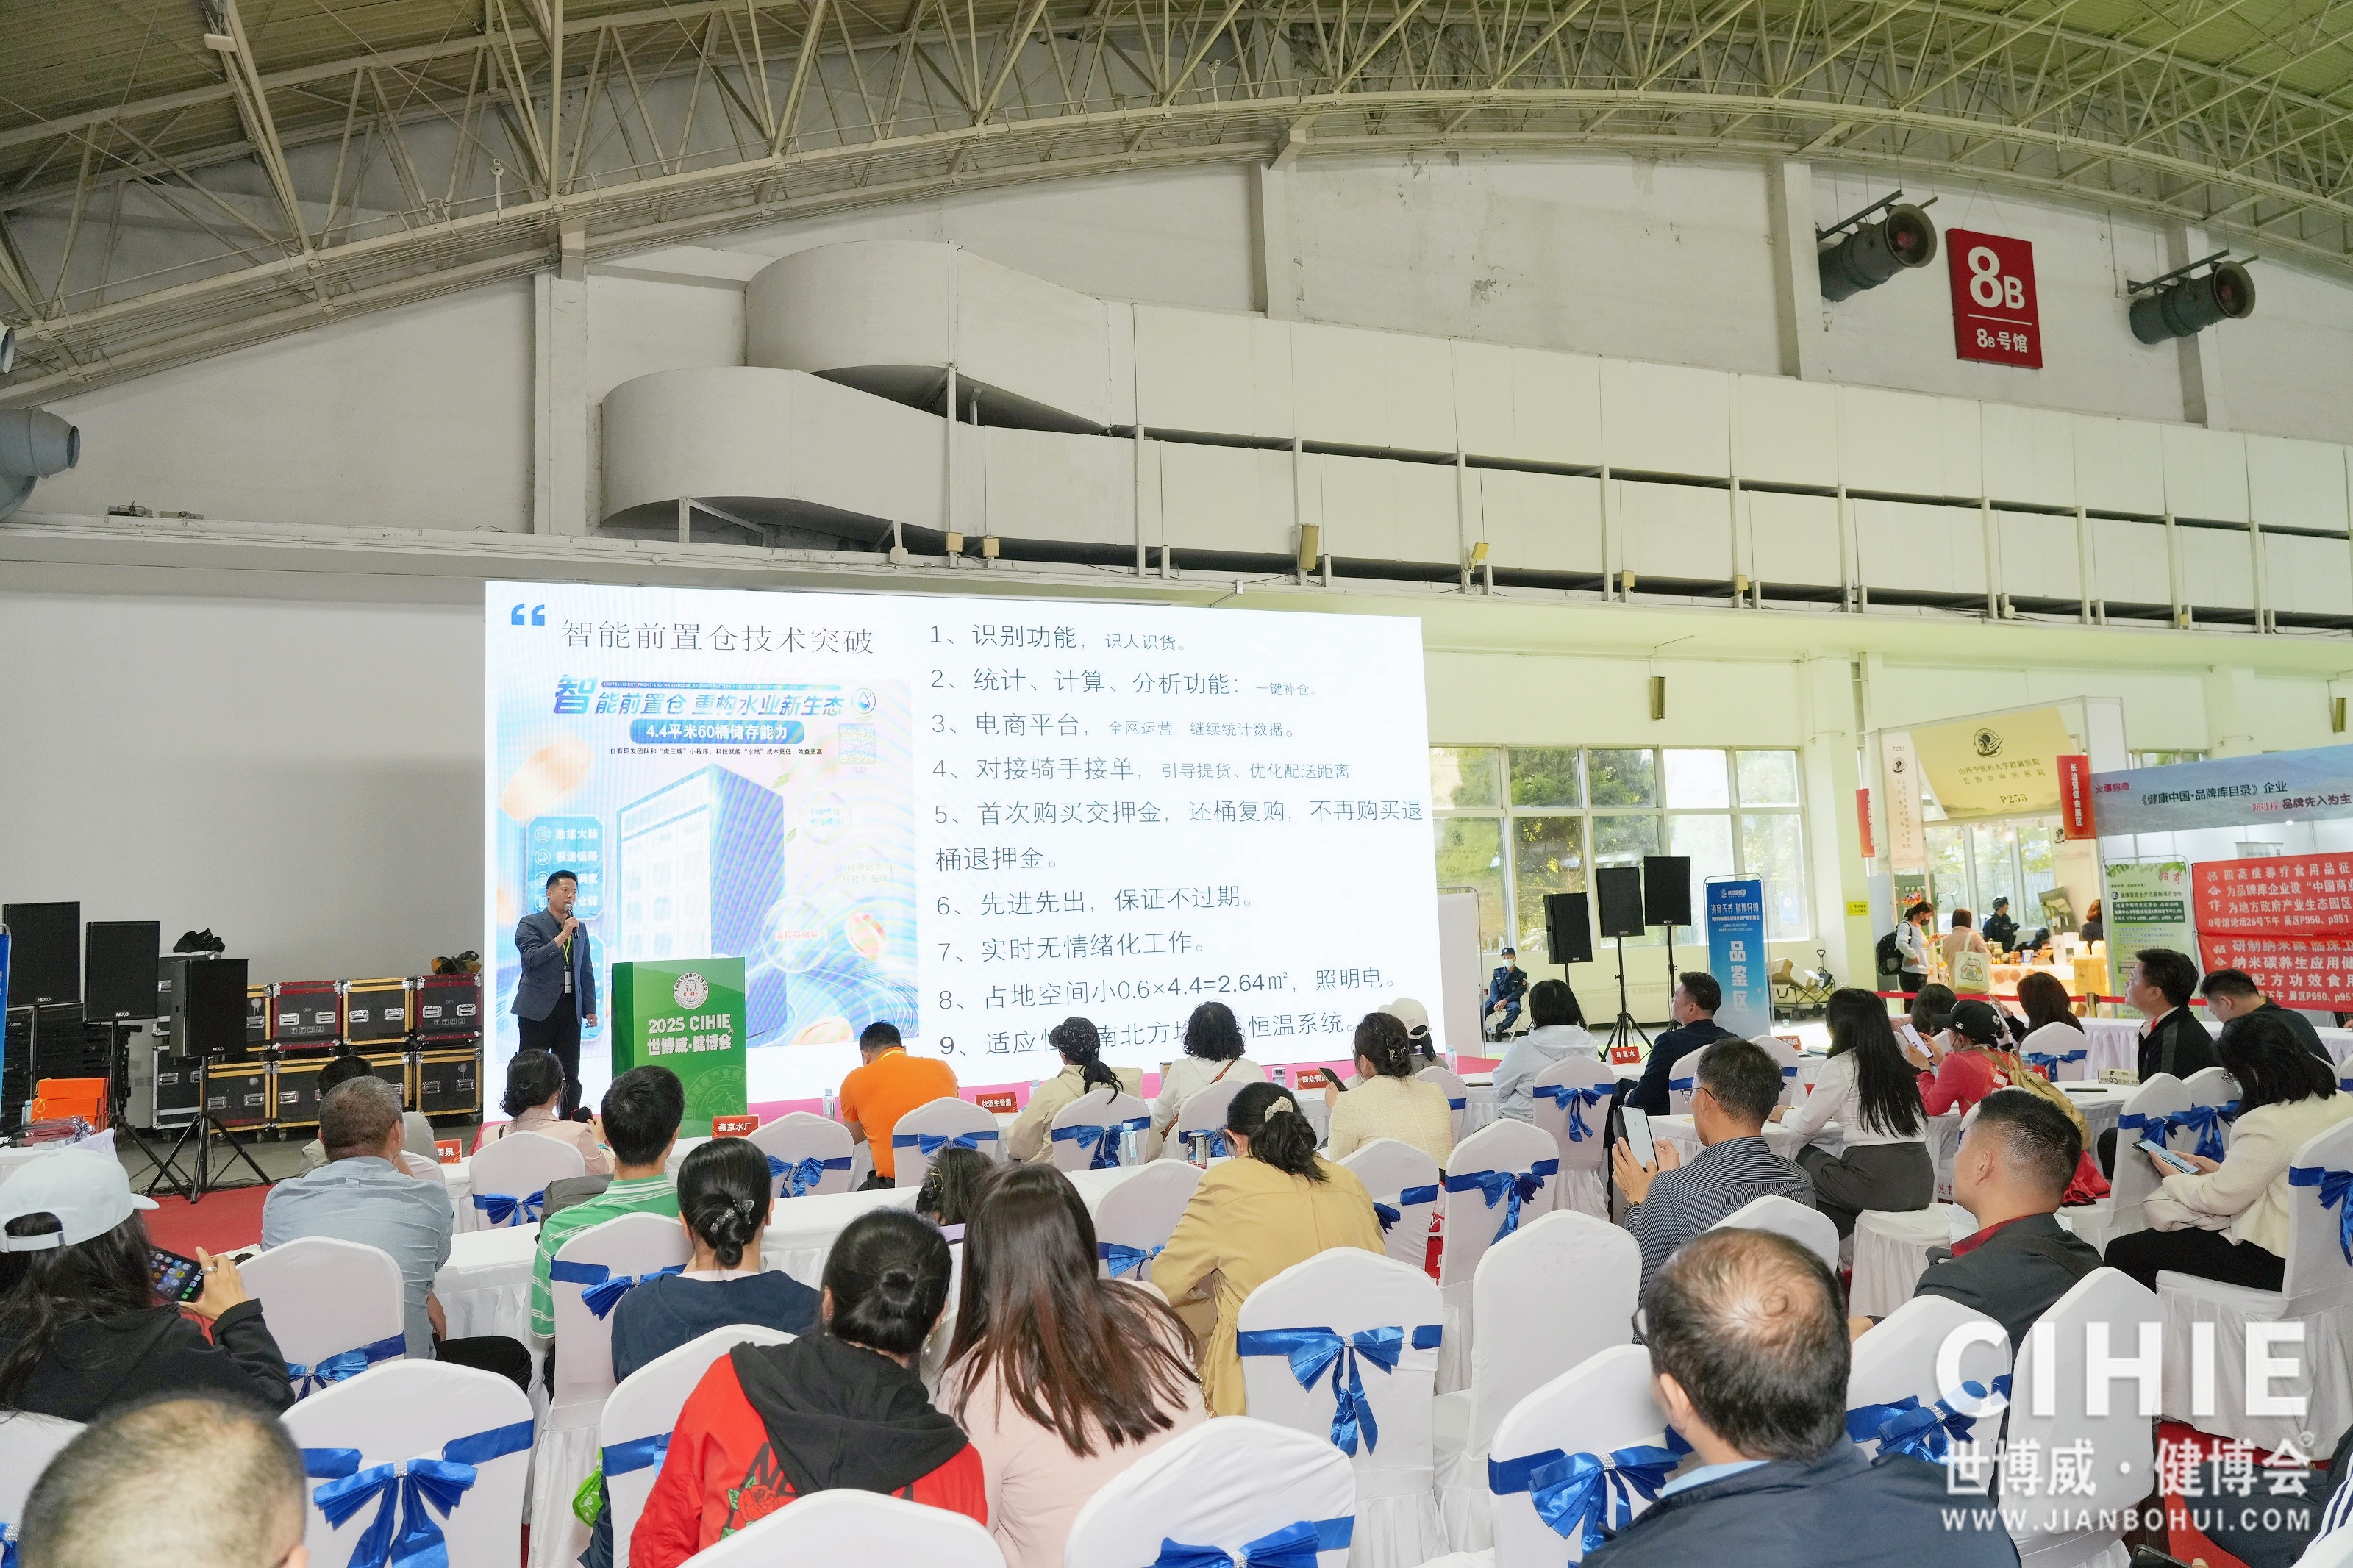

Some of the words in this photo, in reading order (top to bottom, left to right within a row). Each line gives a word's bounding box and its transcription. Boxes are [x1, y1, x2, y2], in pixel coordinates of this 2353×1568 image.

[1968, 246, 2025, 309] 8B
[1976, 328, 2028, 353] 8B号馆
[561, 619, 874, 654] 智能前置仓技术突破
[691, 694, 845, 717] 重构水业新生态
[646, 723, 788, 740] 4.4平米60桶储存能力
[1958, 758, 2041, 776] 山西中医药大学附属医院
[1999, 793, 2028, 804] P253
[935, 846, 1058, 873] 桶退押金。
[938, 930, 1204, 963] 7、实时无情绪化工作。
[648, 1017, 685, 1034] 2025
[689, 1014, 732, 1031] CIHIE
[718, 1122, 752, 1133] 燕京水厂
